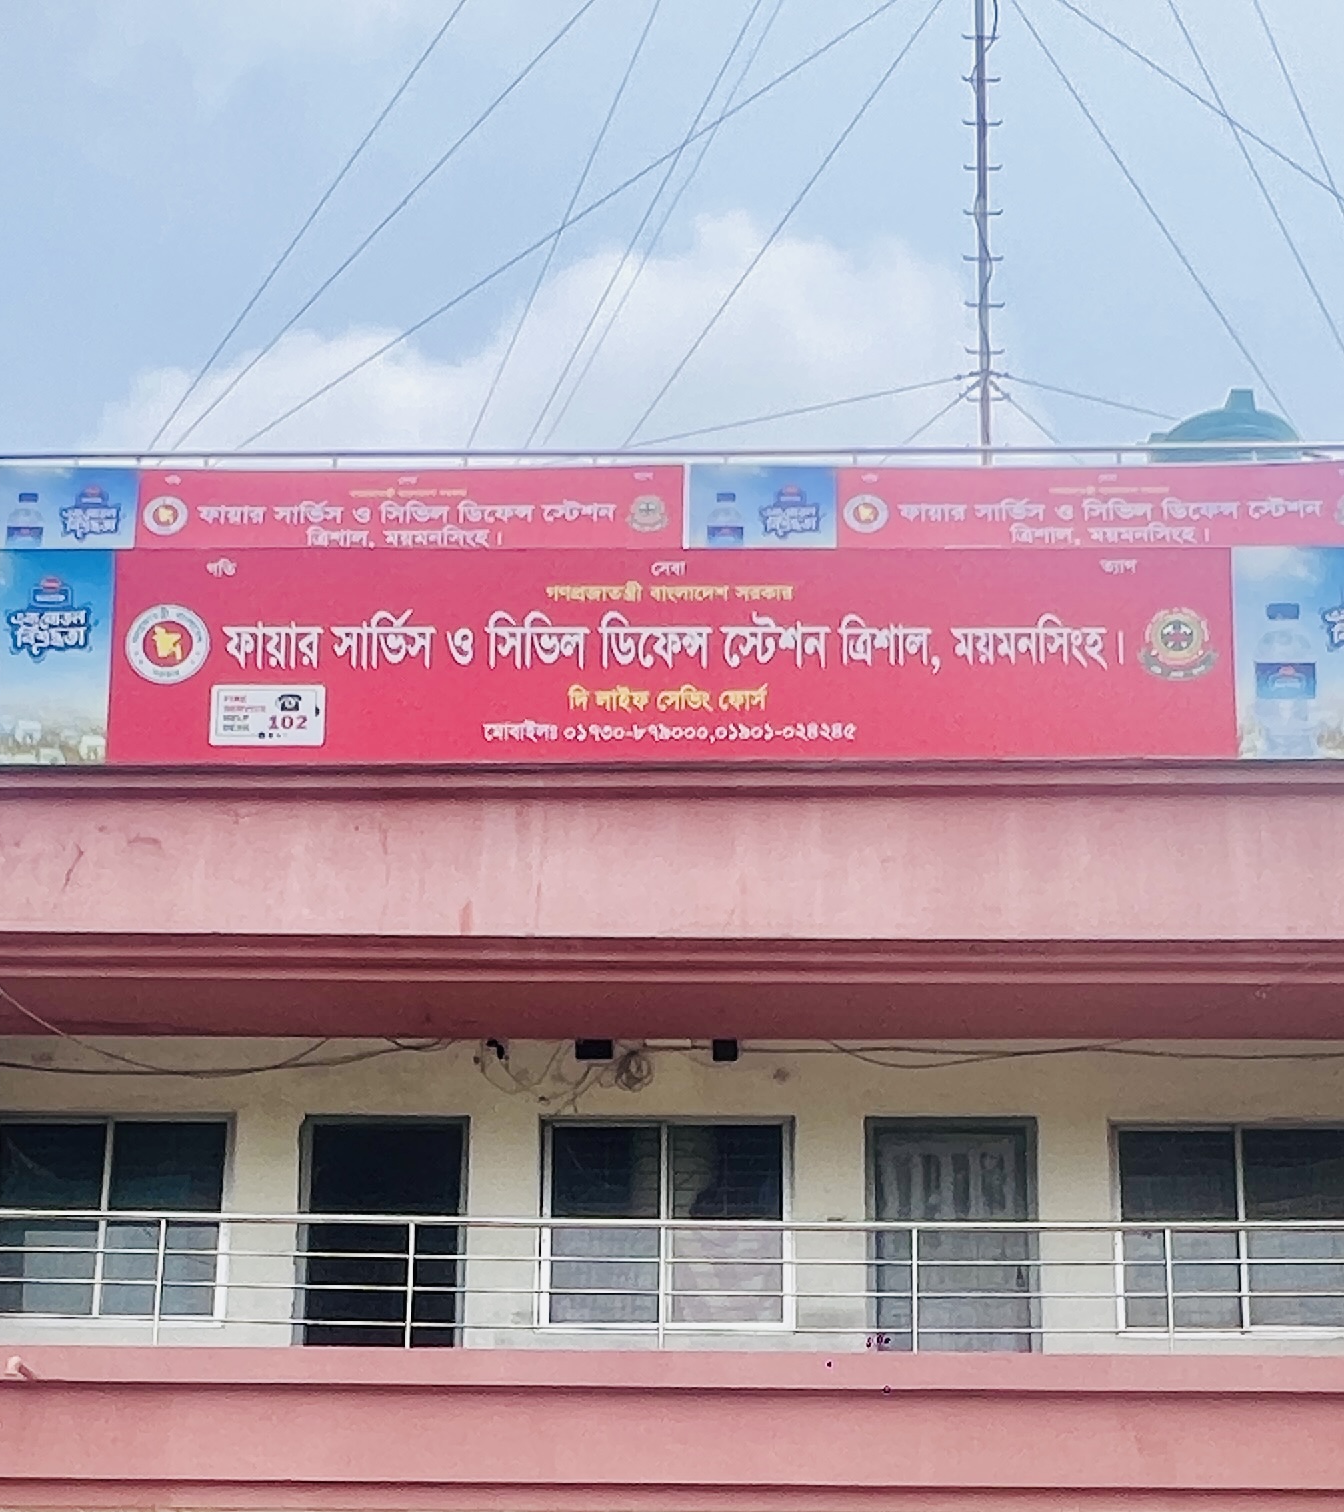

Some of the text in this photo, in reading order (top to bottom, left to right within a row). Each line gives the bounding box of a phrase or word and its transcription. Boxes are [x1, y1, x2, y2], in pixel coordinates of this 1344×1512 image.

[197, 503, 267, 526] ফায়ার
[273, 500, 344, 526] সার্ভিস
[353, 506, 371, 524] ও
[380, 500, 450, 525] সিভিল
[897, 503, 967, 523] ফায়ার
[974, 498, 1045, 522] সার্ভিস
[1054, 504, 1074, 521] ও
[1081, 498, 1152, 521] সিভিল
[650, 560, 686, 577] সেবা
[650, 585, 729, 603] বাংলাদেশ
[735, 585, 794, 602] সরকার
[222, 620, 324, 670] ফায়ার
[329, 609, 437, 670] সার্ভিস
[446, 626, 475, 666] ও
[485, 611, 591, 670] সিভিল
[599, 611, 713, 669] ডিফেন্স
[719, 611, 832, 670] স্টেশন
[837, 613, 942, 675] ত্রিশাল,
[567, 684, 590, 711] দি
[595, 685, 650, 713] লাইফ
[718, 682, 769, 711] ফোর্স
[269, 714, 308, 730] 102
